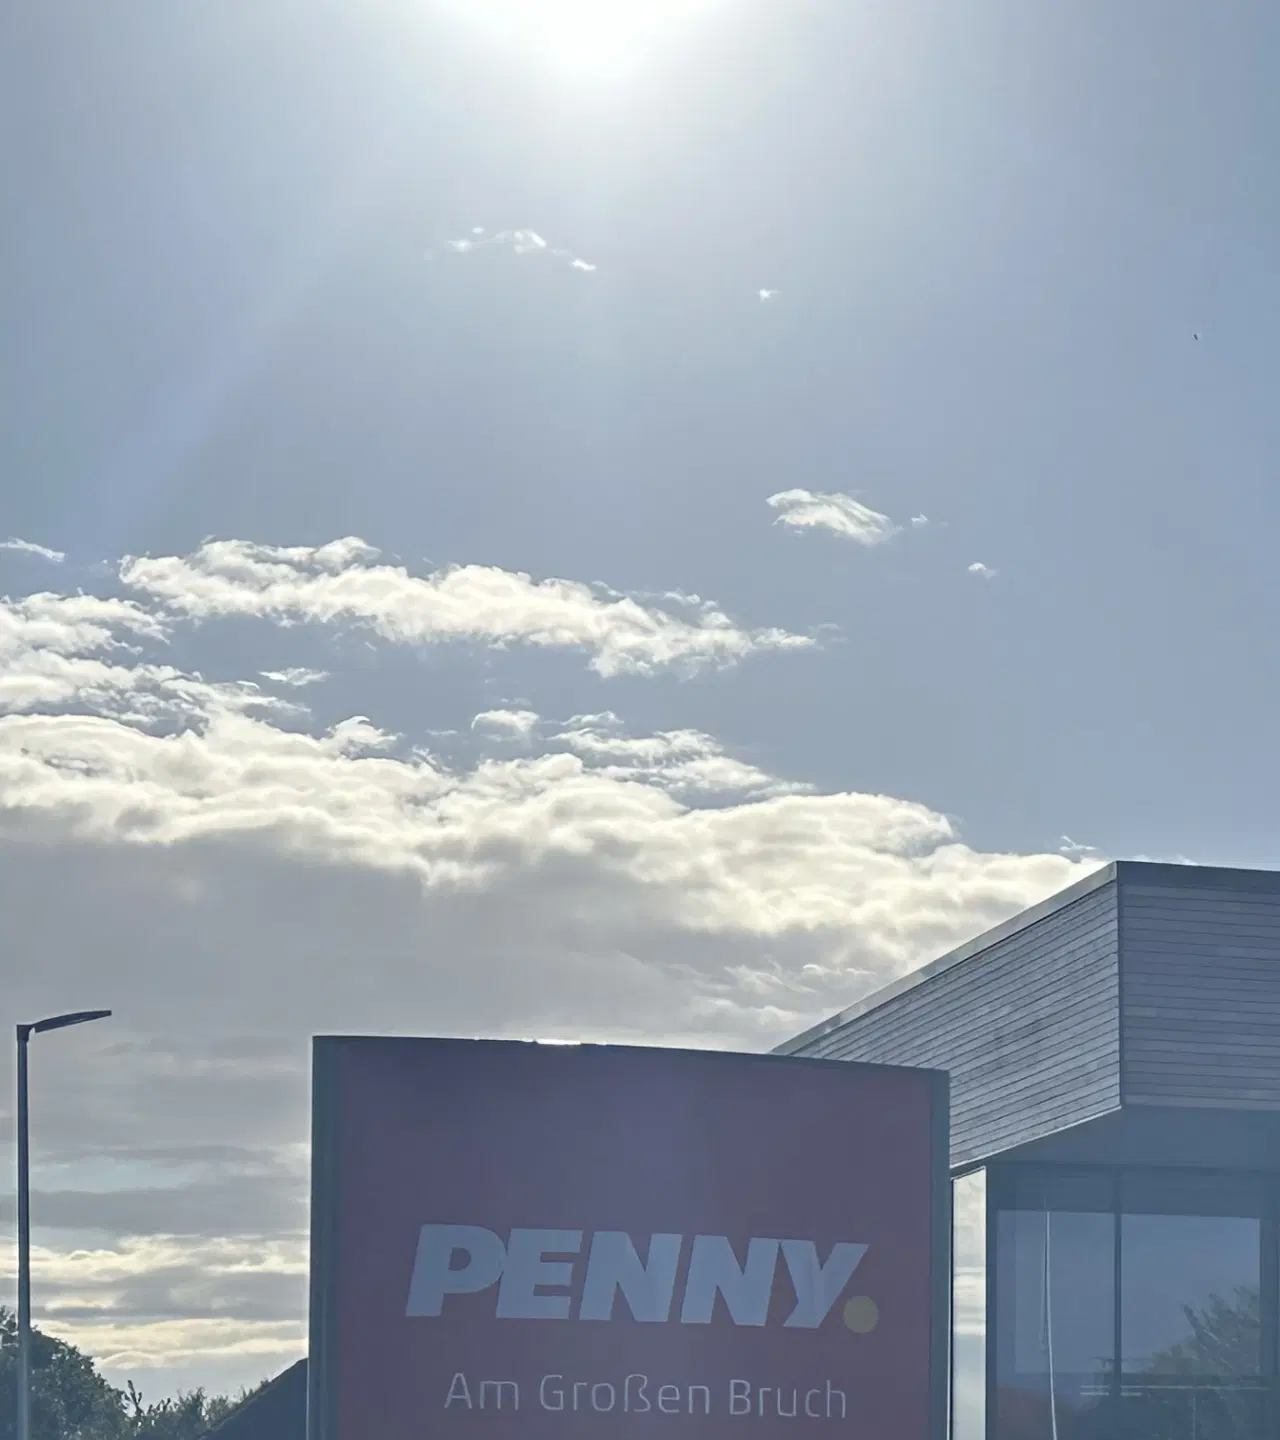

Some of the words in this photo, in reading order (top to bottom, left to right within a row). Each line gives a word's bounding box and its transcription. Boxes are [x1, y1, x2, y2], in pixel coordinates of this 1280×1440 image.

[444, 1372, 519, 1410] Am
[538, 1373, 710, 1415] Großen
[729, 1378, 847, 1419] Bruch
